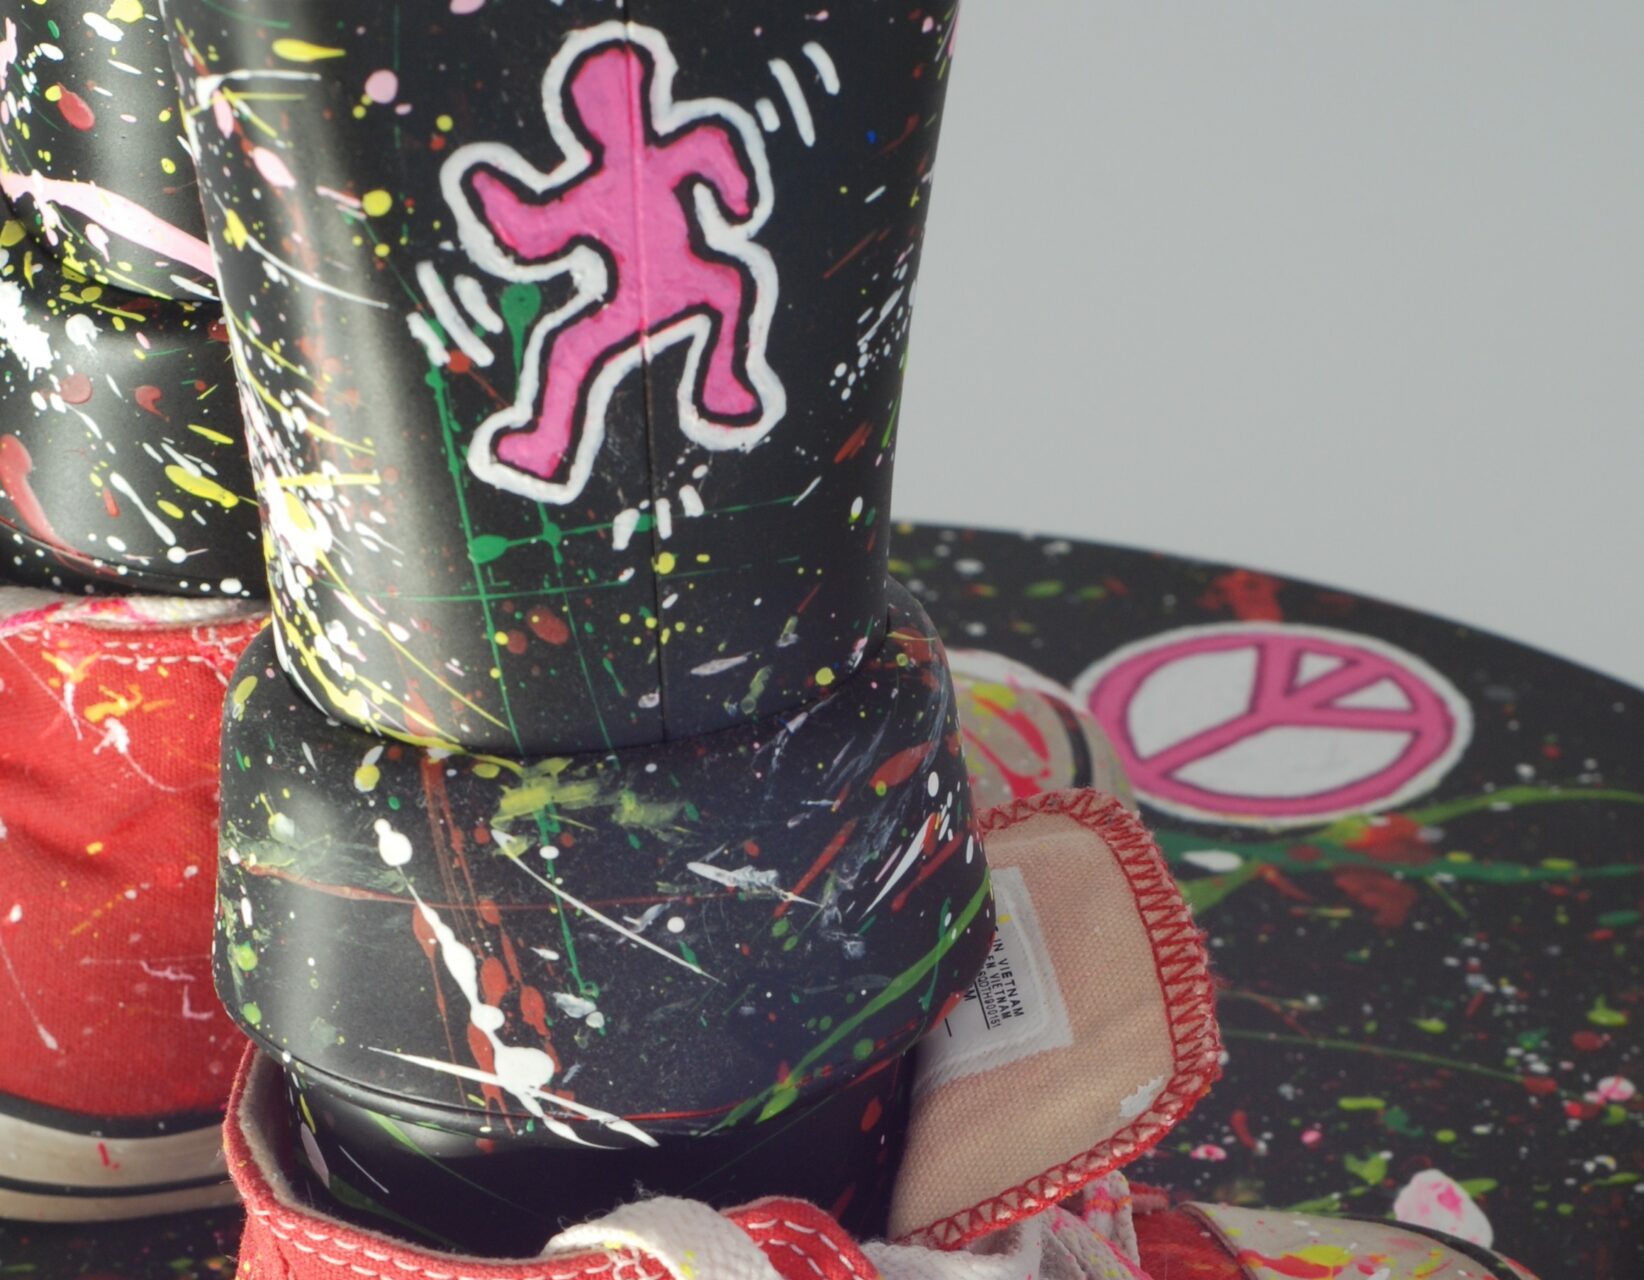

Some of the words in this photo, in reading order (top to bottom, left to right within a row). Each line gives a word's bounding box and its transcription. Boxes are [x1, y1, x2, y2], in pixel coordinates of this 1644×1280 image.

[993, 938, 1005, 952] IN
[990, 972, 1013, 1020] VIETNAM
[998, 958, 1025, 1017] VIETNAM
